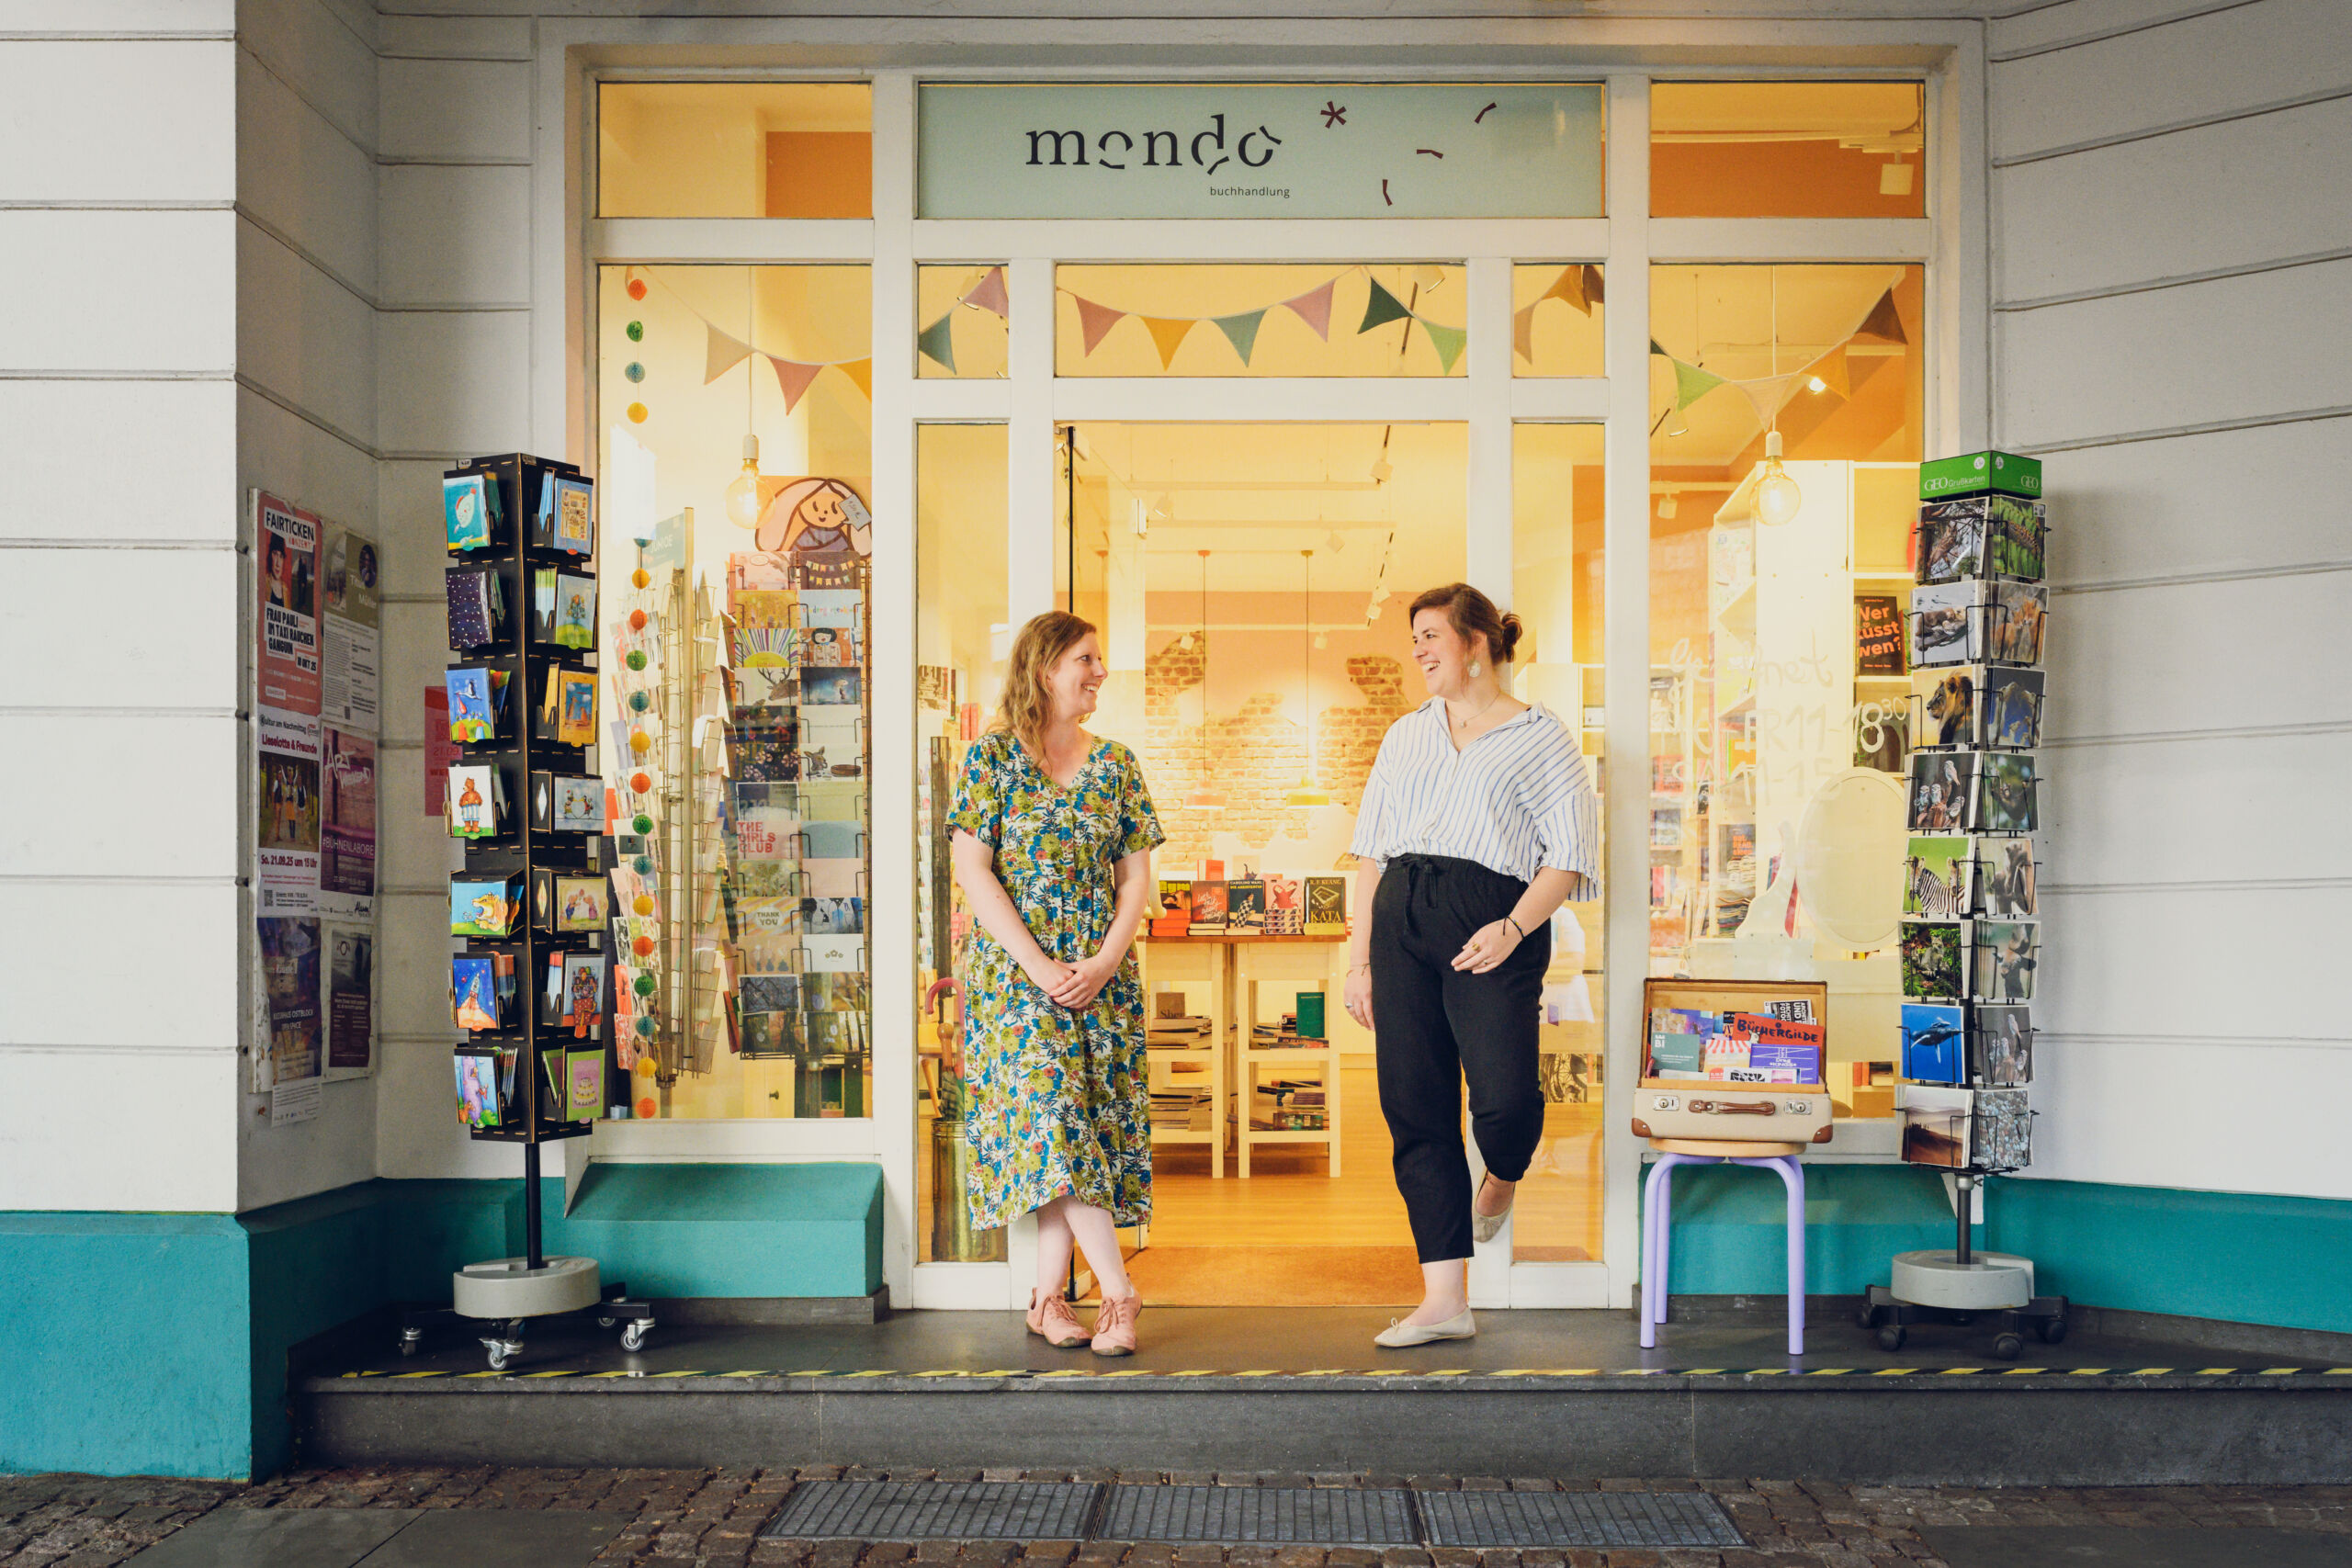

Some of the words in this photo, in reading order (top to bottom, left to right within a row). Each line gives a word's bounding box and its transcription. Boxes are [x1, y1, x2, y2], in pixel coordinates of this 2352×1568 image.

[1025, 113, 1283, 175] mondo
[1210, 186, 1291, 199] buchhandlung
[1924, 477, 1949, 491] GEO
[1949, 475, 1985, 488] Grußkarten
[2020, 475, 2039, 490] GEO
[266, 511, 314, 541] FAIRTICKEN
[266, 607, 282, 624] FRAU
[282, 612, 299, 628] PAULI
[276, 624, 288, 639] TAXI
[289, 628, 314, 647] RAUCHEN
[283, 721, 307, 735] Nachmittag
[291, 739, 296, 750] &
[296, 739, 318, 754] Freunde
[738, 821, 763, 832] THE
[738, 832, 776, 843] GIRLS
[322, 835, 375, 856] #BÜHNENLABORE
[739, 843, 774, 853] CLUB
[271, 855, 294, 867] 21.09.25
[294, 859, 303, 867] um
[310, 856, 318, 868] Uhr
[1310, 911, 1342, 921] KATA
[1793, 1002, 1802, 1020] UND
